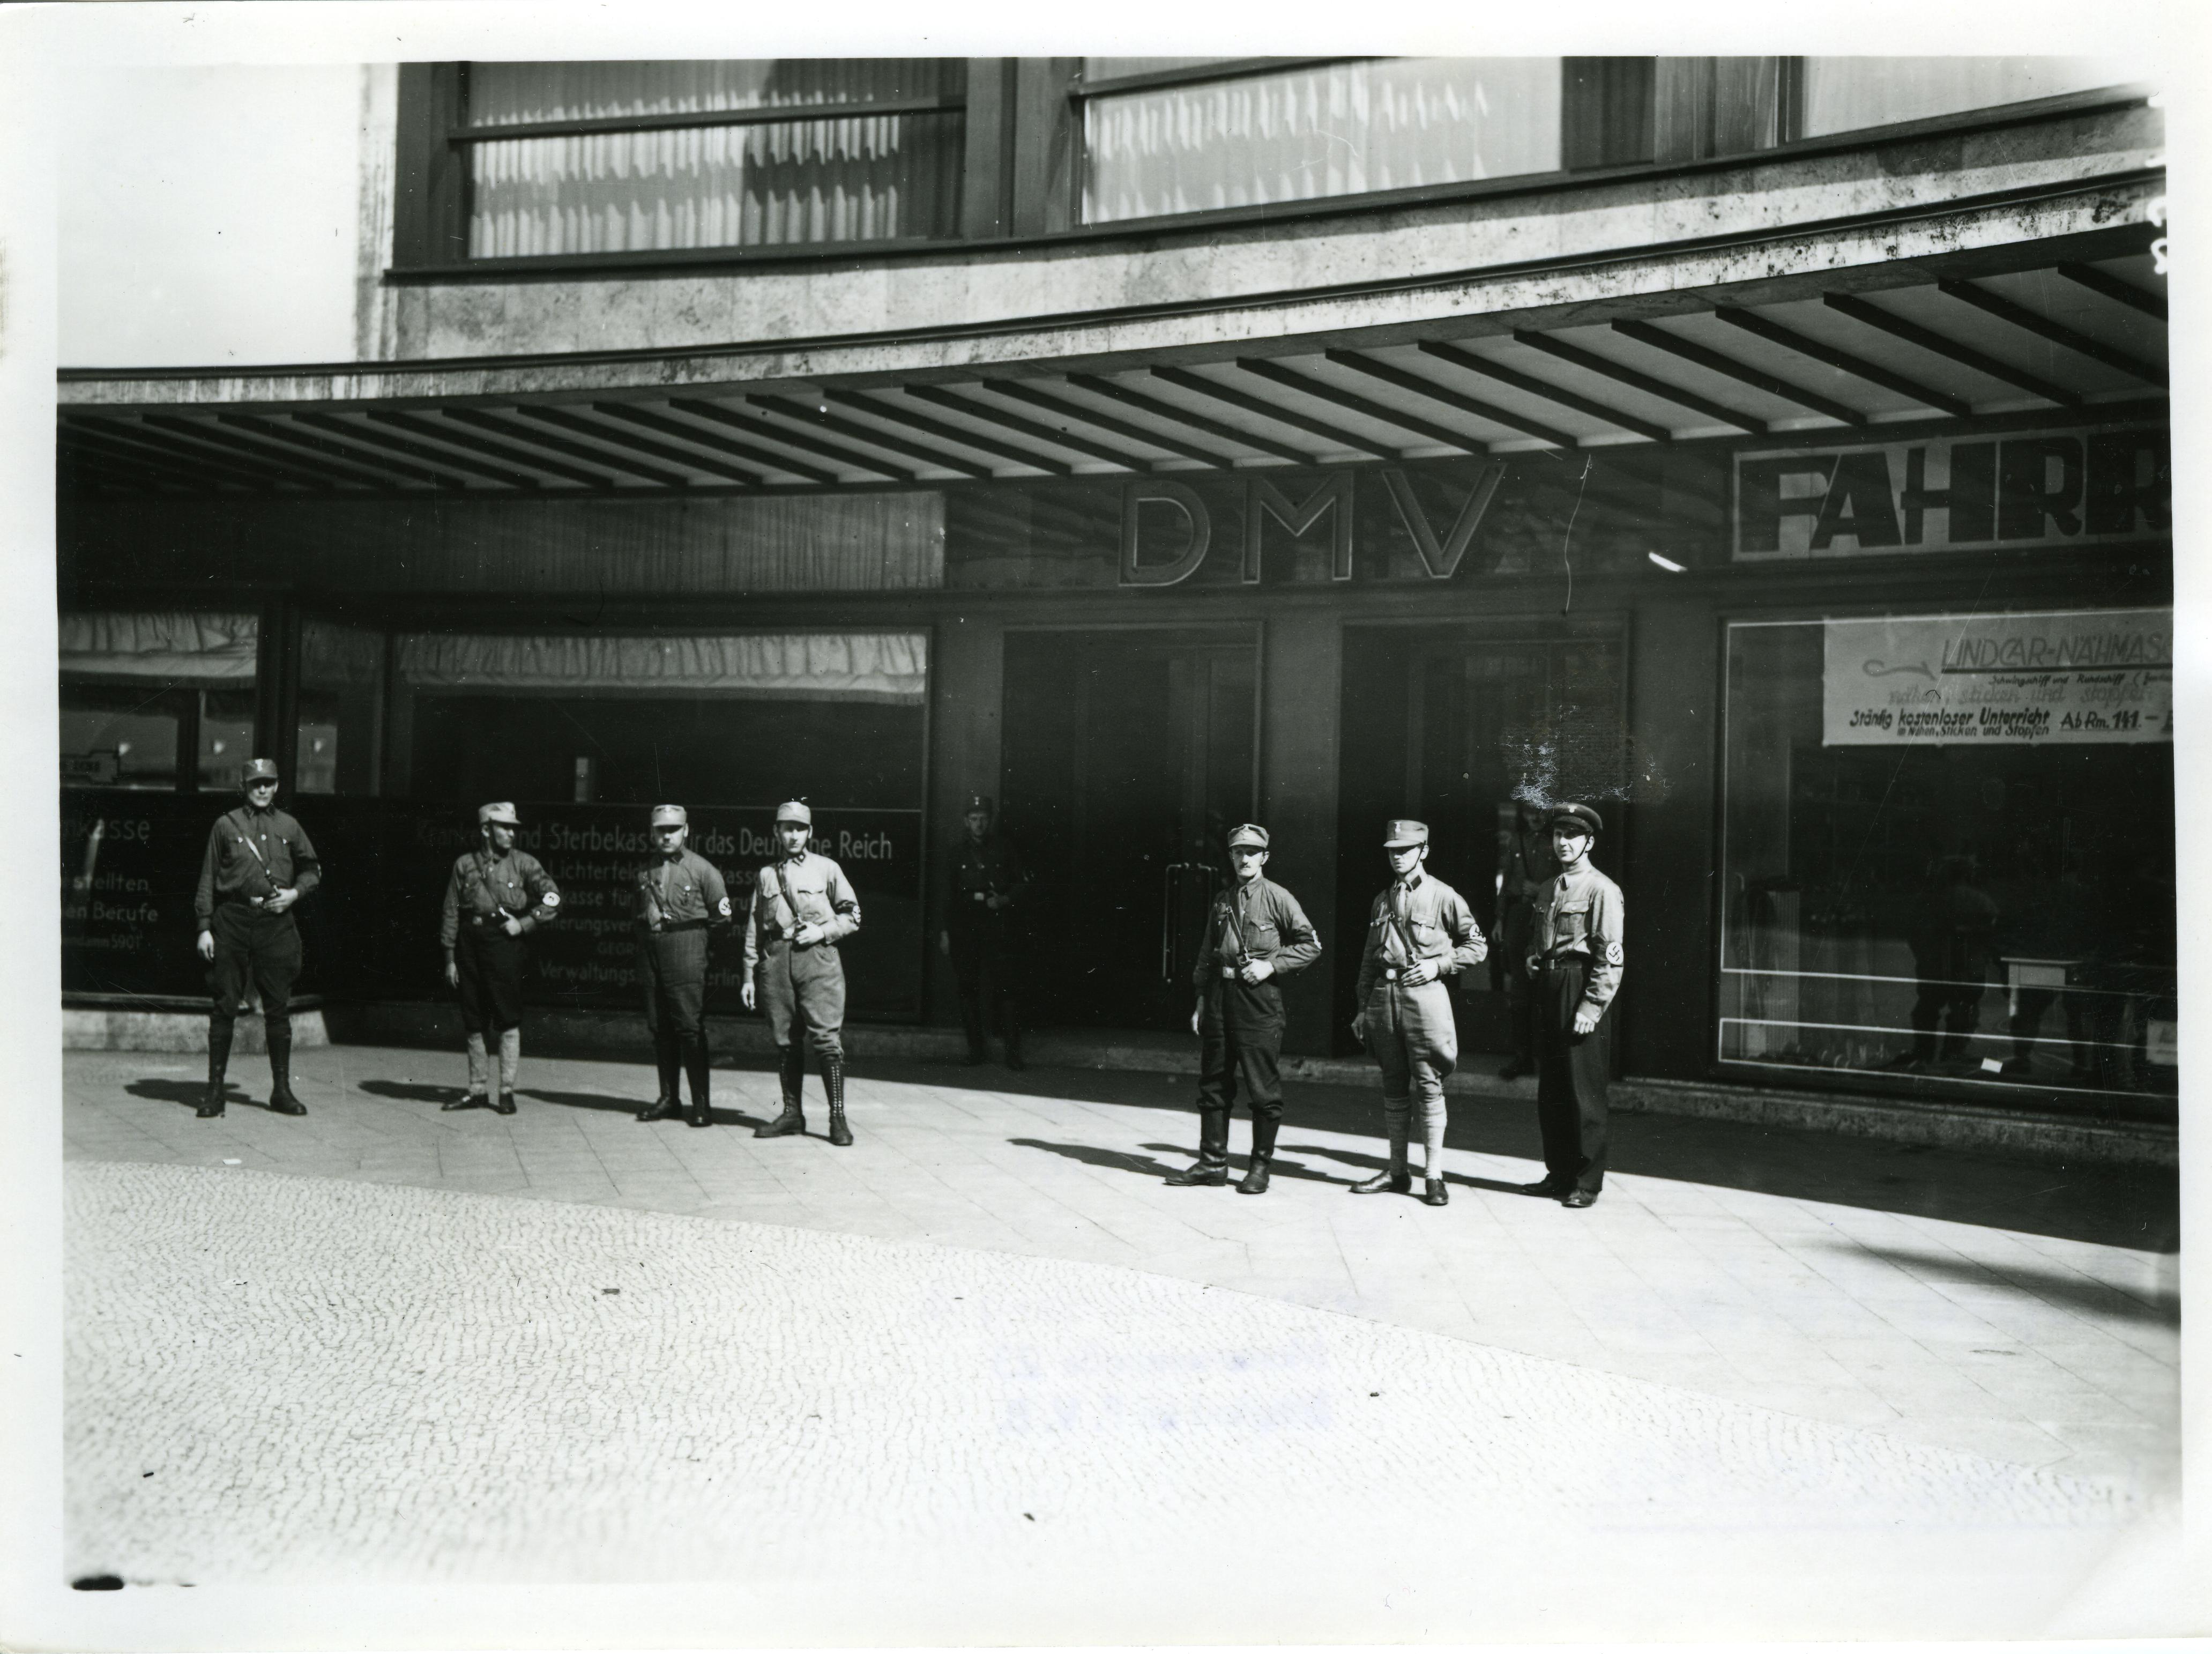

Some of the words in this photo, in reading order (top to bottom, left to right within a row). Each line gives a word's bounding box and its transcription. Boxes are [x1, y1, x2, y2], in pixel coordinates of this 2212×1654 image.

[1118, 463, 1507, 587] DMV
[2052, 675, 2069, 684] und
[1898, 707, 1975, 726] kostenloser
[1979, 706, 2051, 726] Unterricht
[2060, 711, 2082, 729] Ab
[2084, 710, 2110, 729] Rm.
[1982, 725, 2000, 736] und
[2005, 724, 2050, 740] Stopfen
[705, 827, 735, 855] das
[839, 830, 892, 861] Reich
[93, 901, 159, 923] Berufe
[538, 959, 637, 987] Verwaltungs
